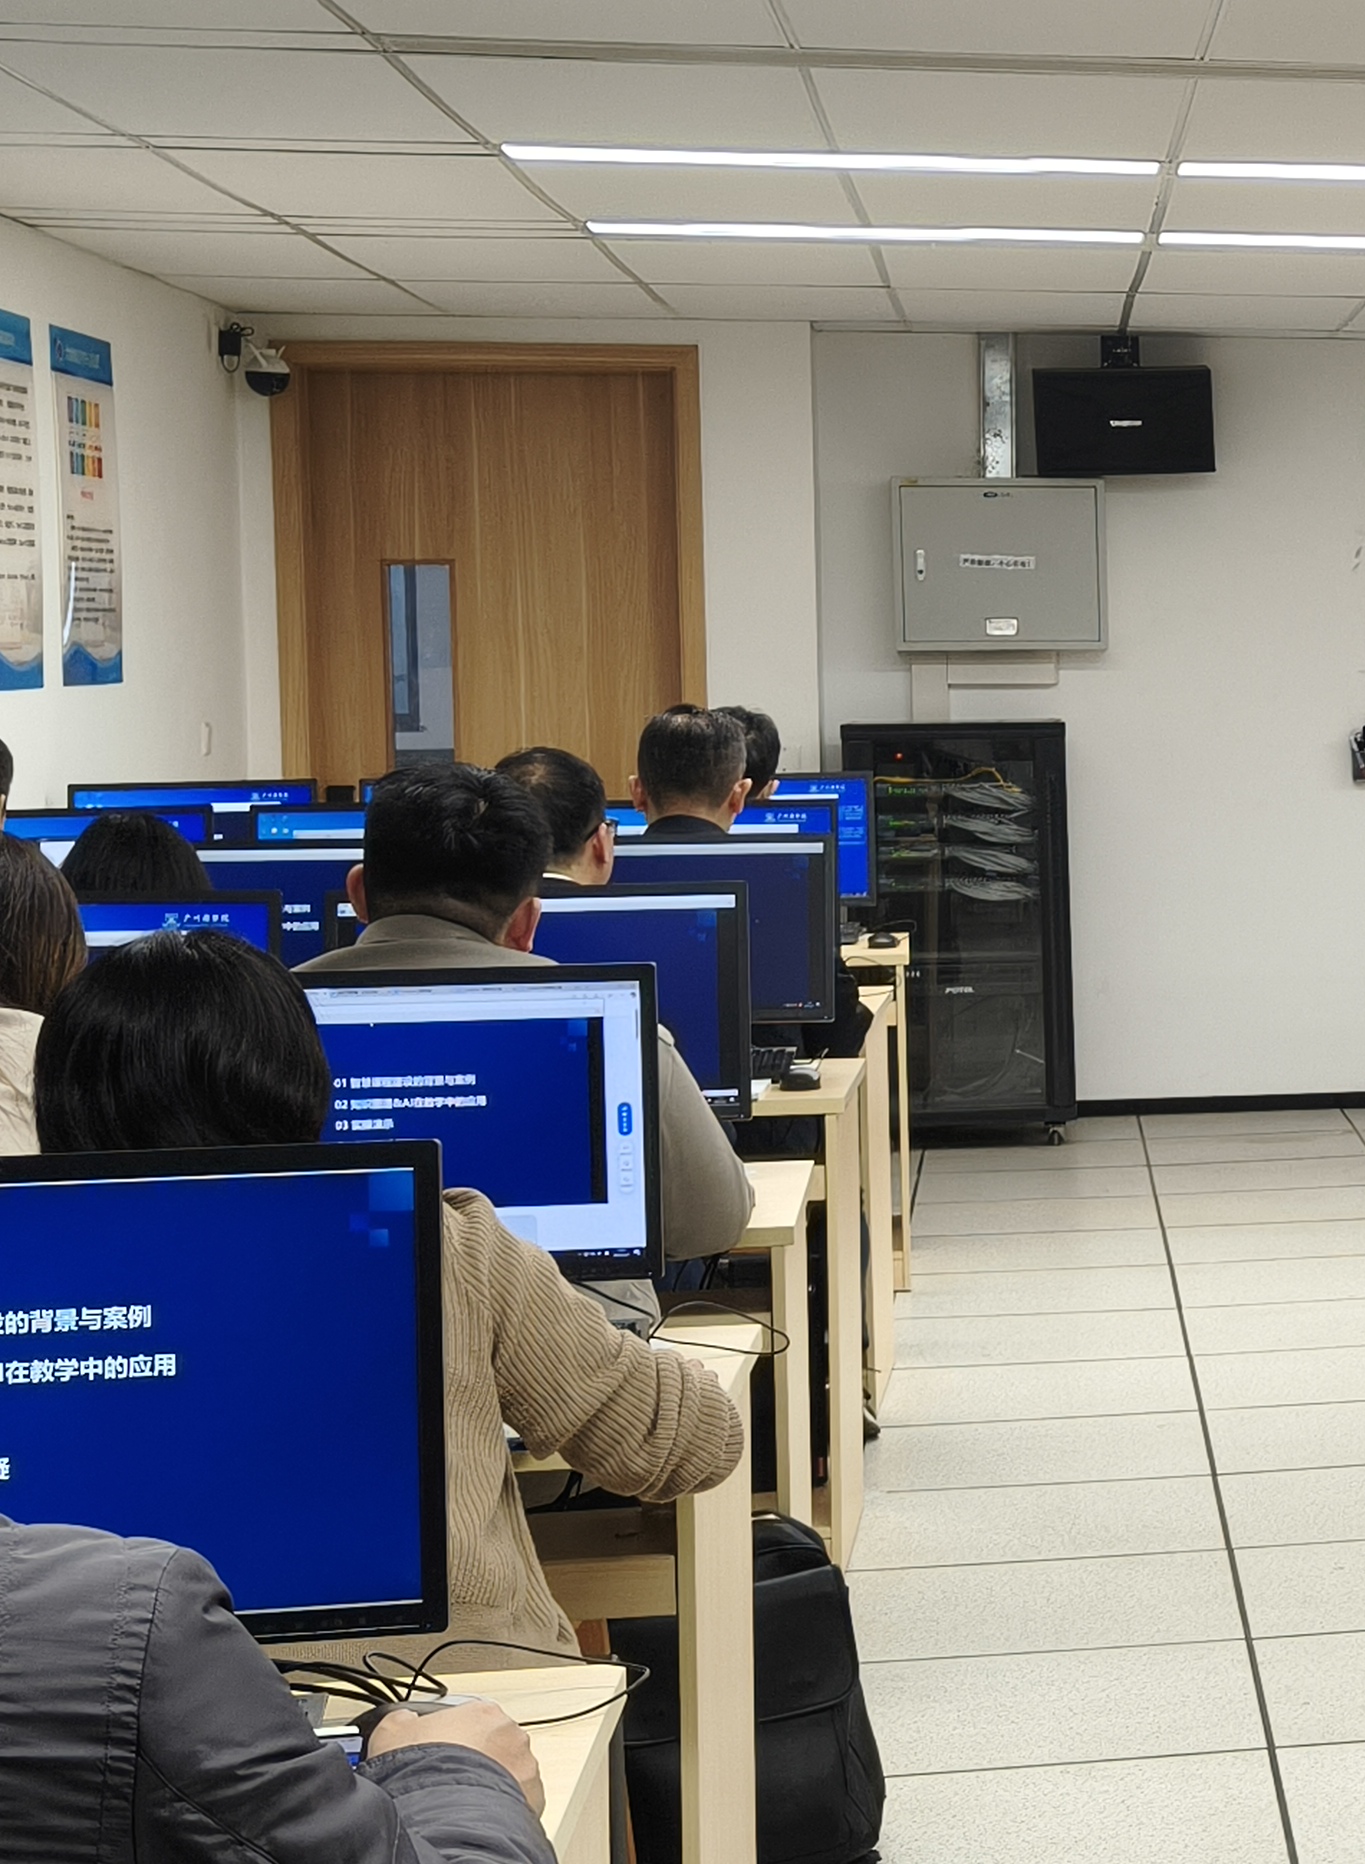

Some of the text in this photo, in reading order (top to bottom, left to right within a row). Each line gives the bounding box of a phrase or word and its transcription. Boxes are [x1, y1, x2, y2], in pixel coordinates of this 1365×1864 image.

[333, 1078, 348, 1088] 01
[334, 1099, 349, 1110] 02
[335, 1120, 349, 1131] 03
[0, 1304, 152, 1335] 的背景与案例
